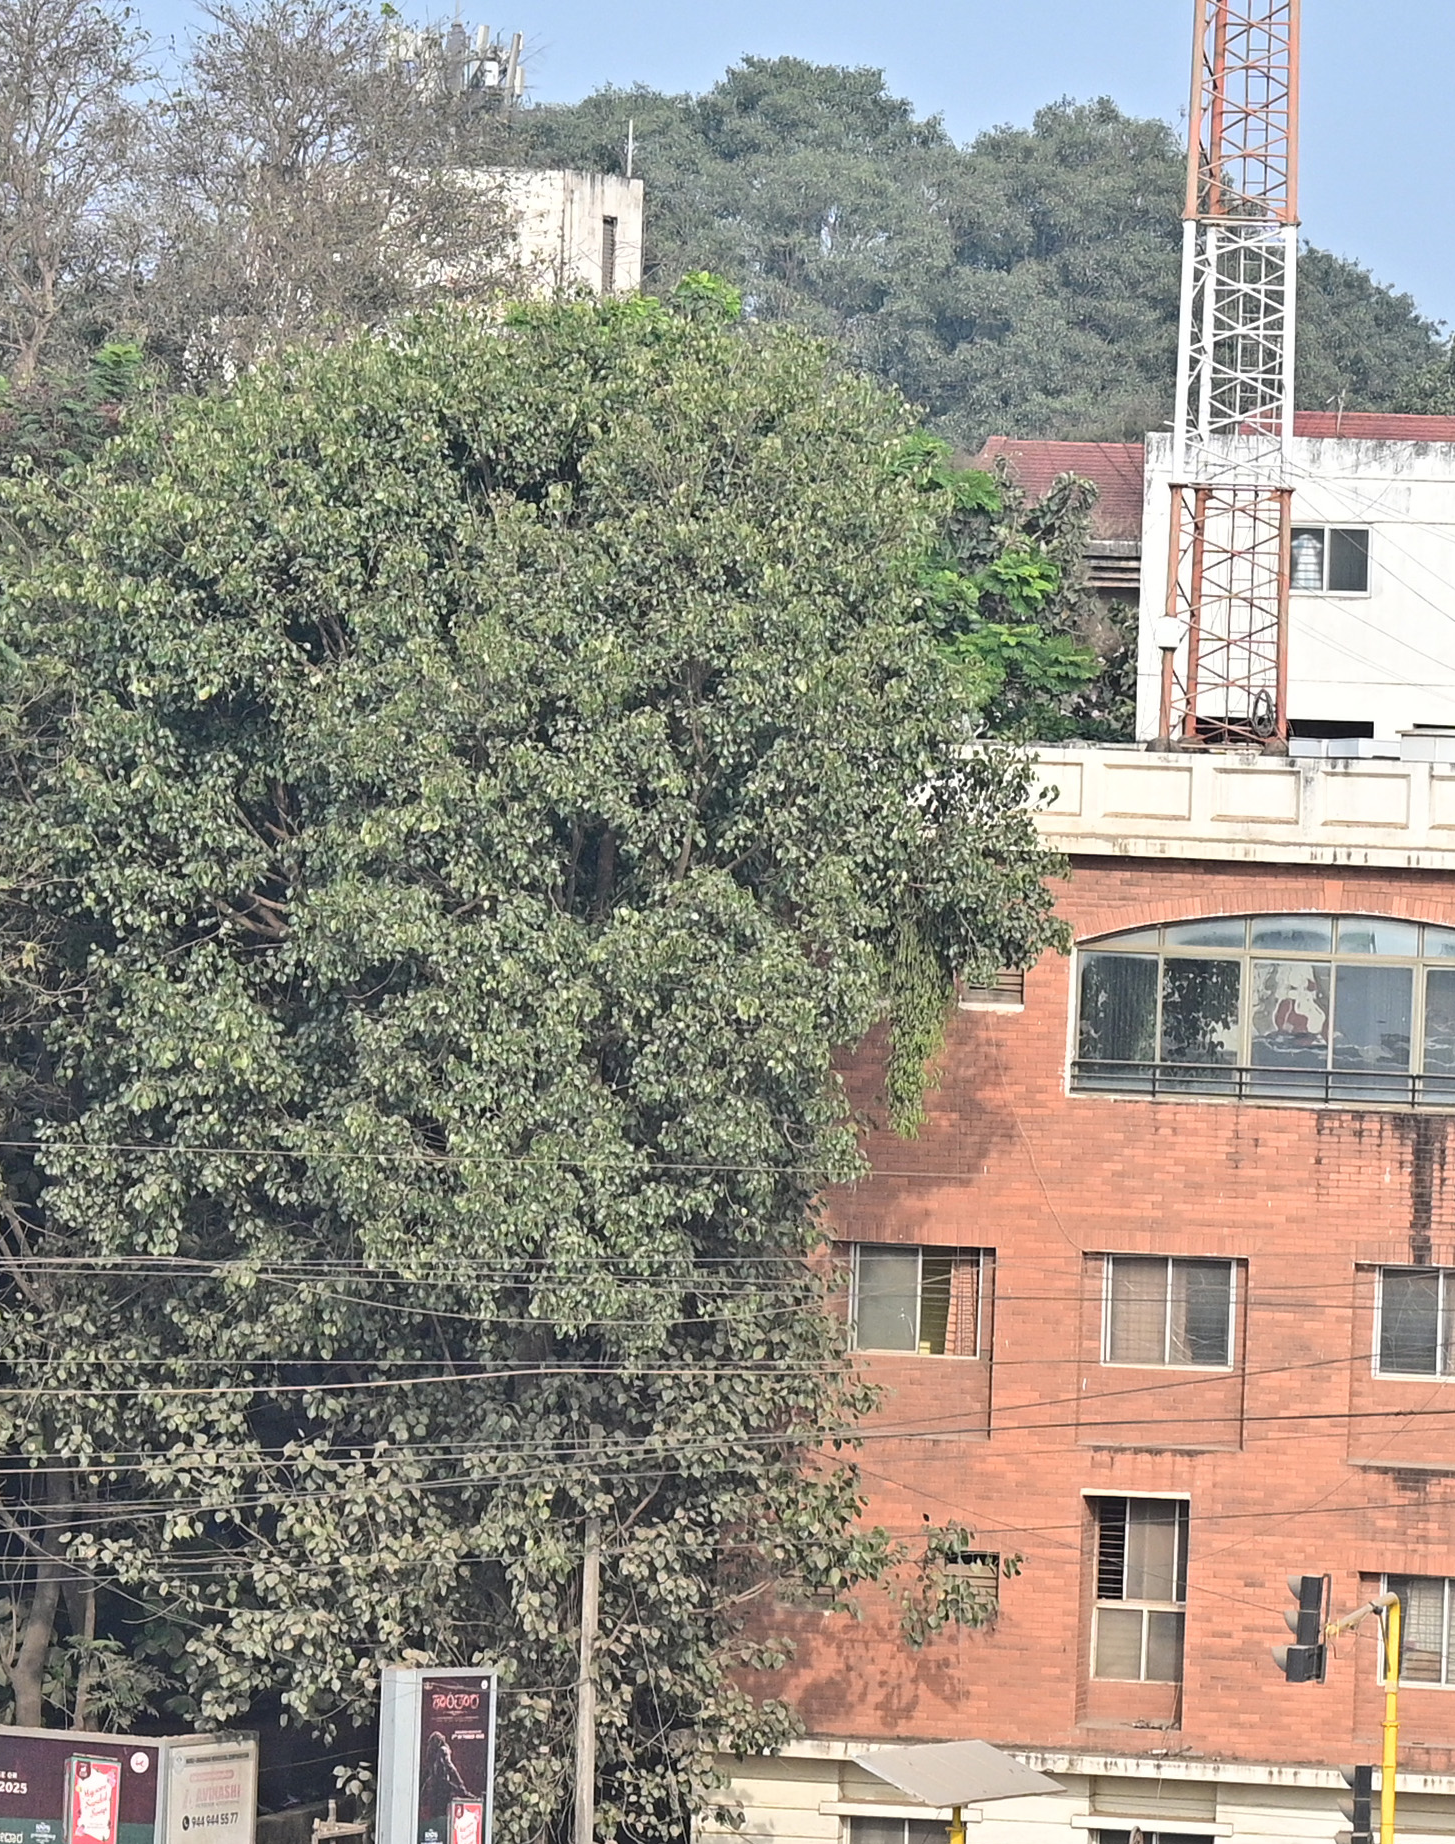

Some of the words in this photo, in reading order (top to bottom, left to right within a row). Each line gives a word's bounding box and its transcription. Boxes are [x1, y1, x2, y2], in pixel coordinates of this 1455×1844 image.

[432, 1691, 479, 1710] ಕಾಂತಾರ
[192, 1816, 205, 1828] 944
[207, 1815, 219, 1827] 944
[220, 1814, 229, 1825] 55
[230, 1812, 239, 1823] 77
